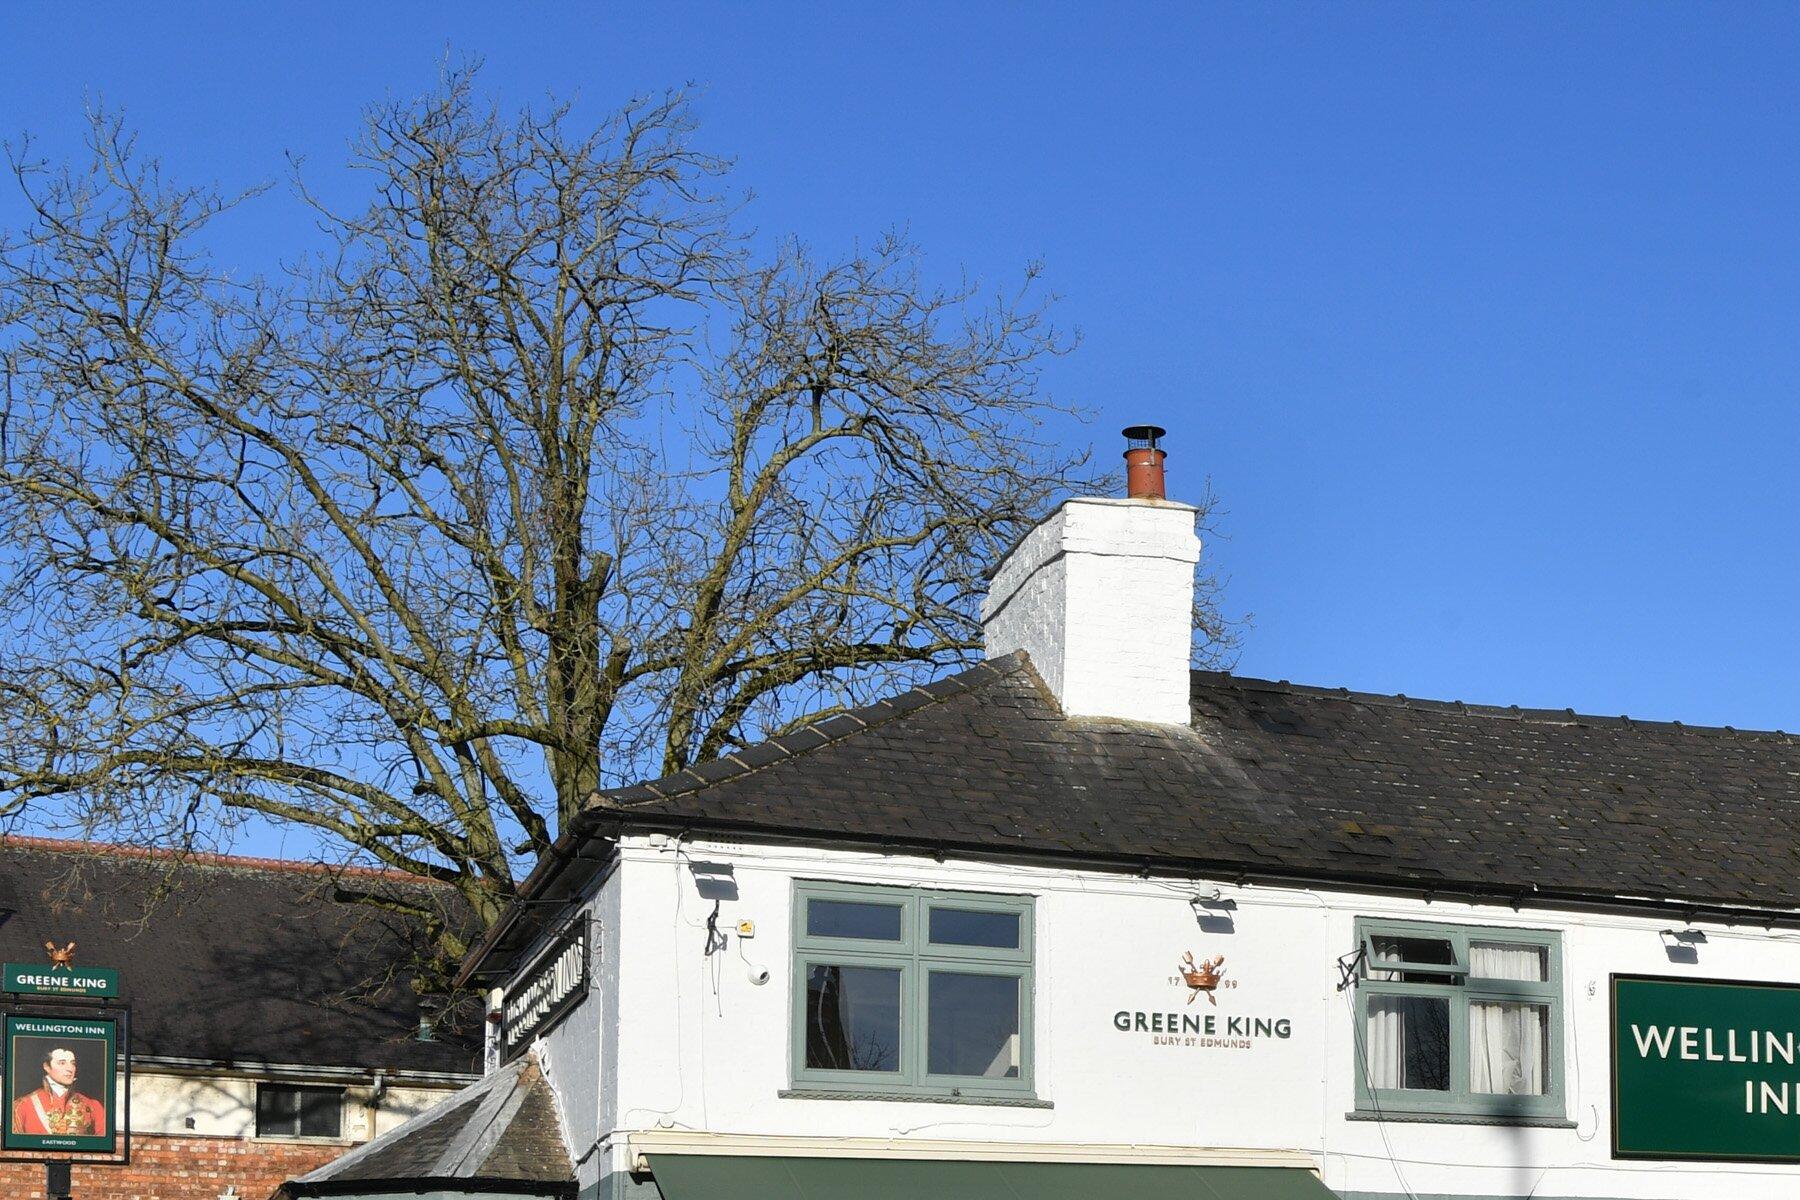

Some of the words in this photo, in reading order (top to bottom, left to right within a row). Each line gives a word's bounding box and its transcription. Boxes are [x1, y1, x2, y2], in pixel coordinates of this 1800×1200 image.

[16, 974, 69, 987] GREENE
[73, 978, 107, 989] KING
[15, 1023, 83, 1033] WELLINGTON
[85, 1027, 105, 1035] INN
[1113, 1010, 1216, 1035] GREENE
[1227, 1016, 1292, 1039] KING
[1153, 1036, 1181, 1046] BURY
[1185, 1037, 1196, 1047] ST
[1200, 1038, 1252, 1049] EDMUNDS
